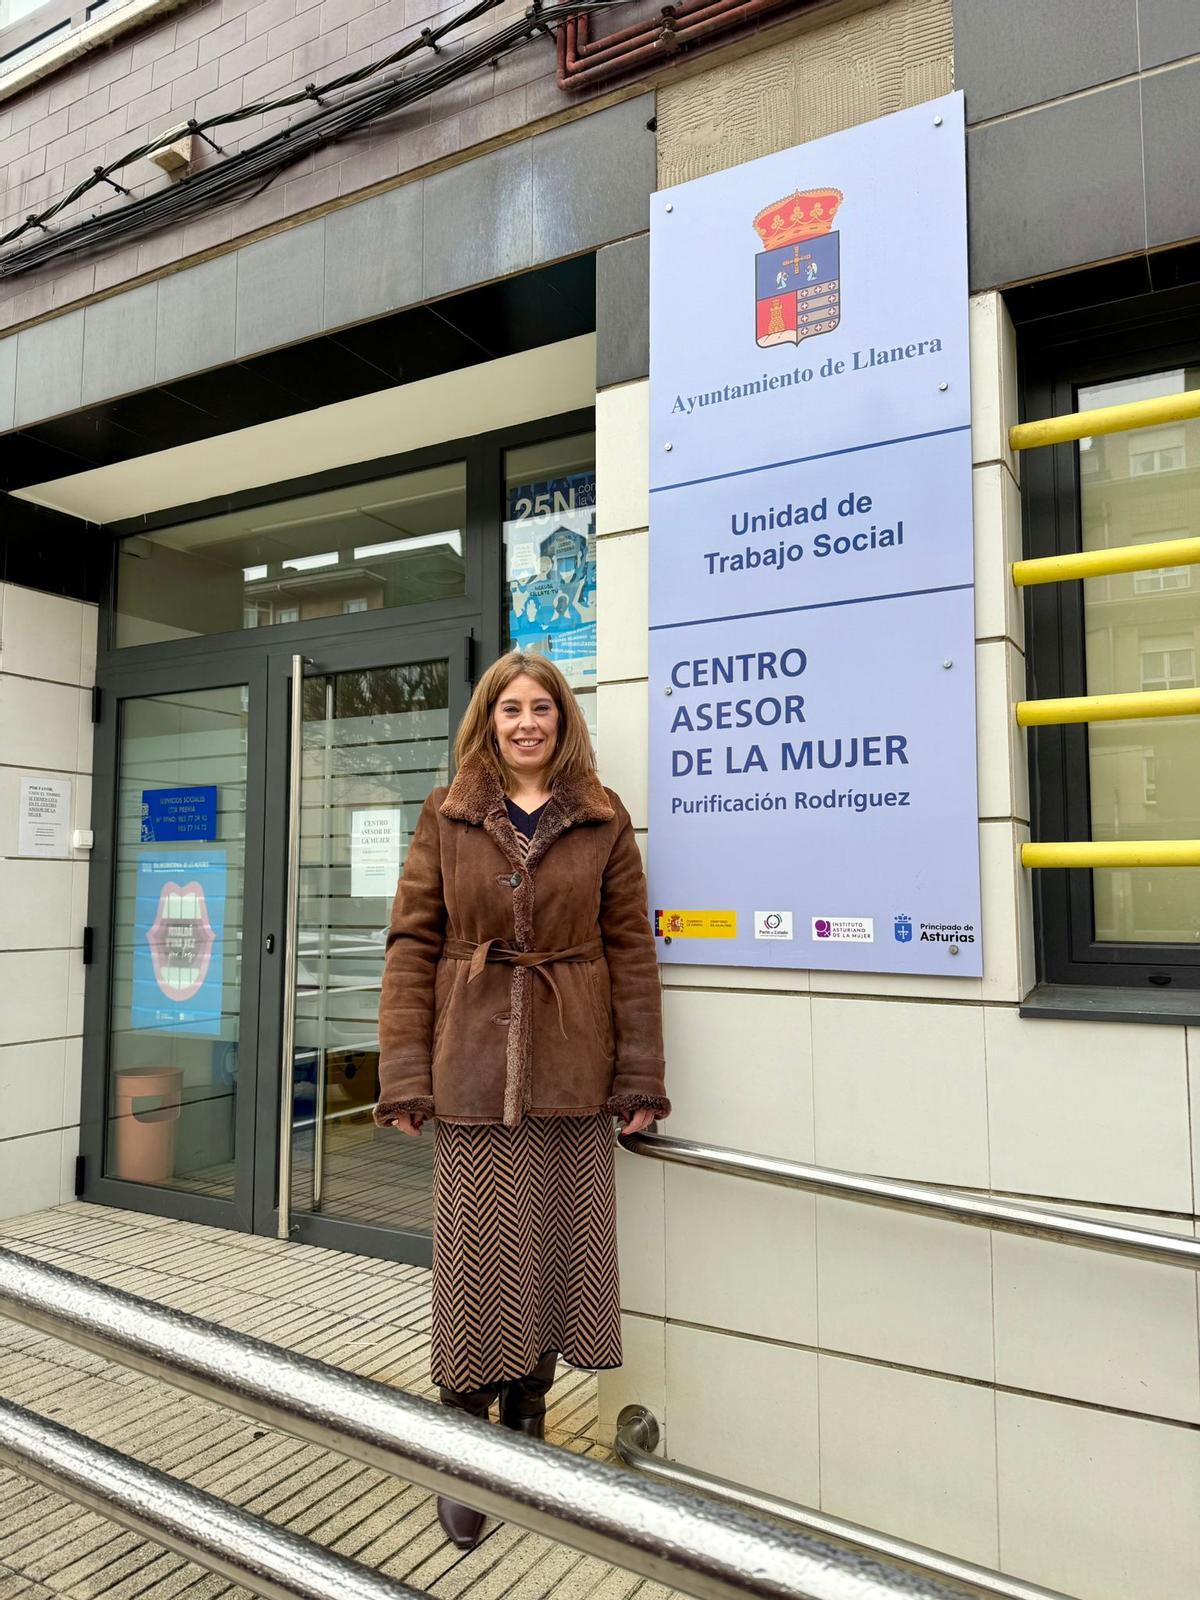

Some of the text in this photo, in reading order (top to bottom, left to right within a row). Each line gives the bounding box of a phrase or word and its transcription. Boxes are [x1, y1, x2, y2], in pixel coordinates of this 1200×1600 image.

[671, 338, 943, 414] Ayuntamiento de Llanera
[515, 487, 576, 528] 25N
[731, 492, 873, 536] Unidad de
[704, 521, 904, 575] Trabajo Social
[671, 648, 807, 689] CENTRO
[670, 695, 806, 733] ASESOR
[671, 734, 909, 777] DE LA MUJER
[671, 789, 911, 814] Purificación Rodríguez
[920, 923, 974, 933] Principado de
[920, 931, 975, 943] Asturias
